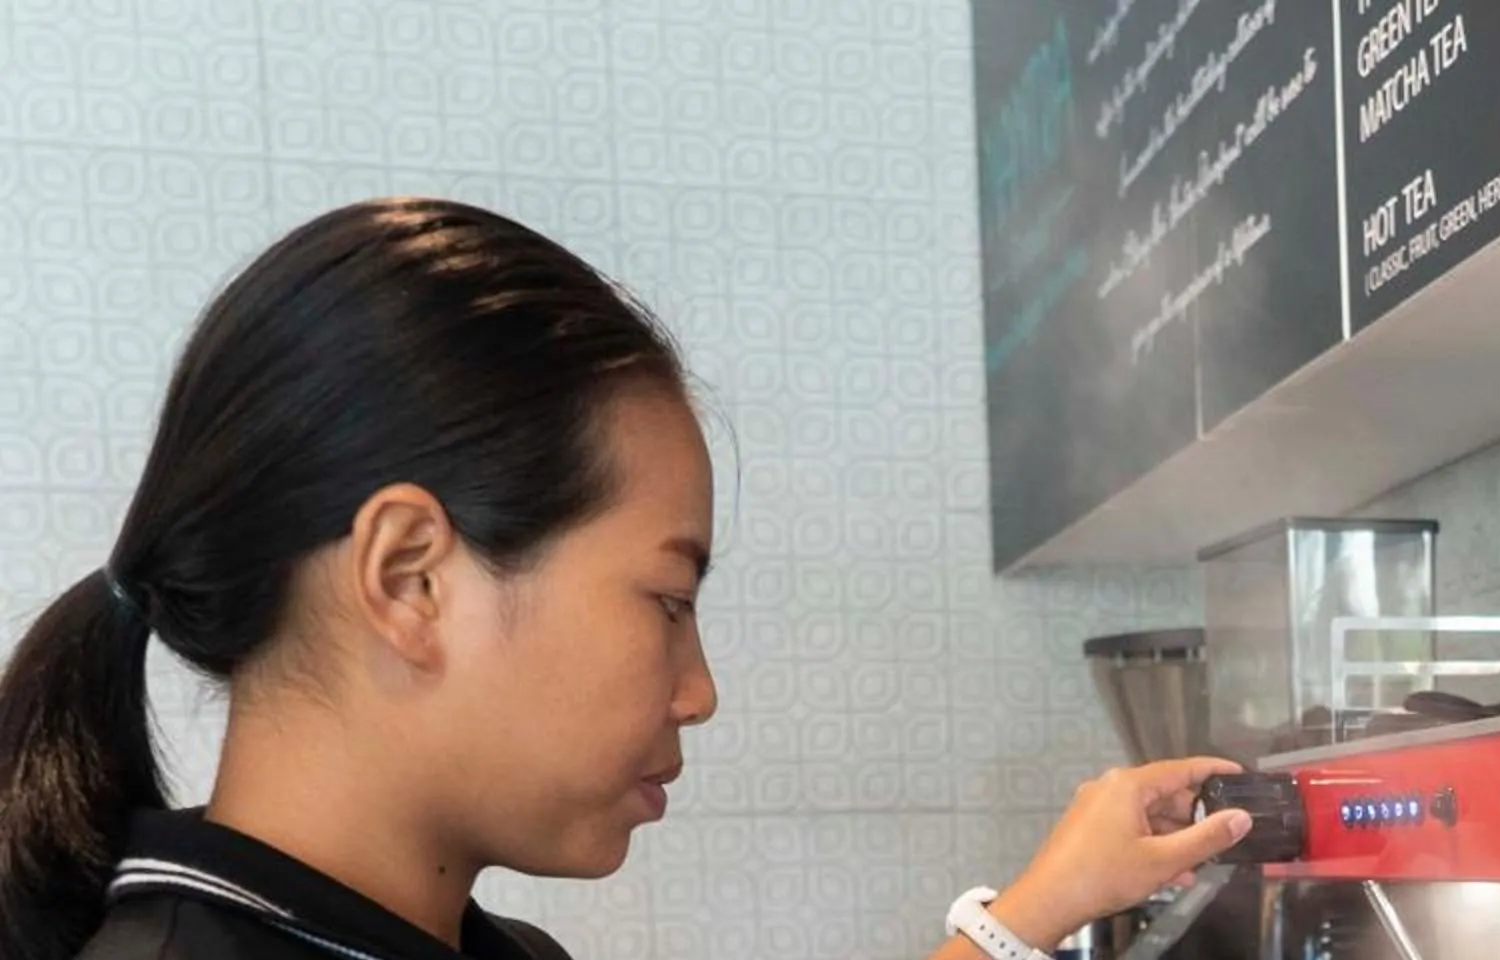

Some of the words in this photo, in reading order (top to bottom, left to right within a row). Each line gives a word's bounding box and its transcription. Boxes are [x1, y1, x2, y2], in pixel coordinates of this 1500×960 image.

[1357, 0, 1412, 77] GREEN
[1359, 48, 1430, 143] MATCHA
[1429, 14, 1467, 76] TEA
[1363, 196, 1398, 256] HOT
[1401, 168, 1437, 225] TEA
